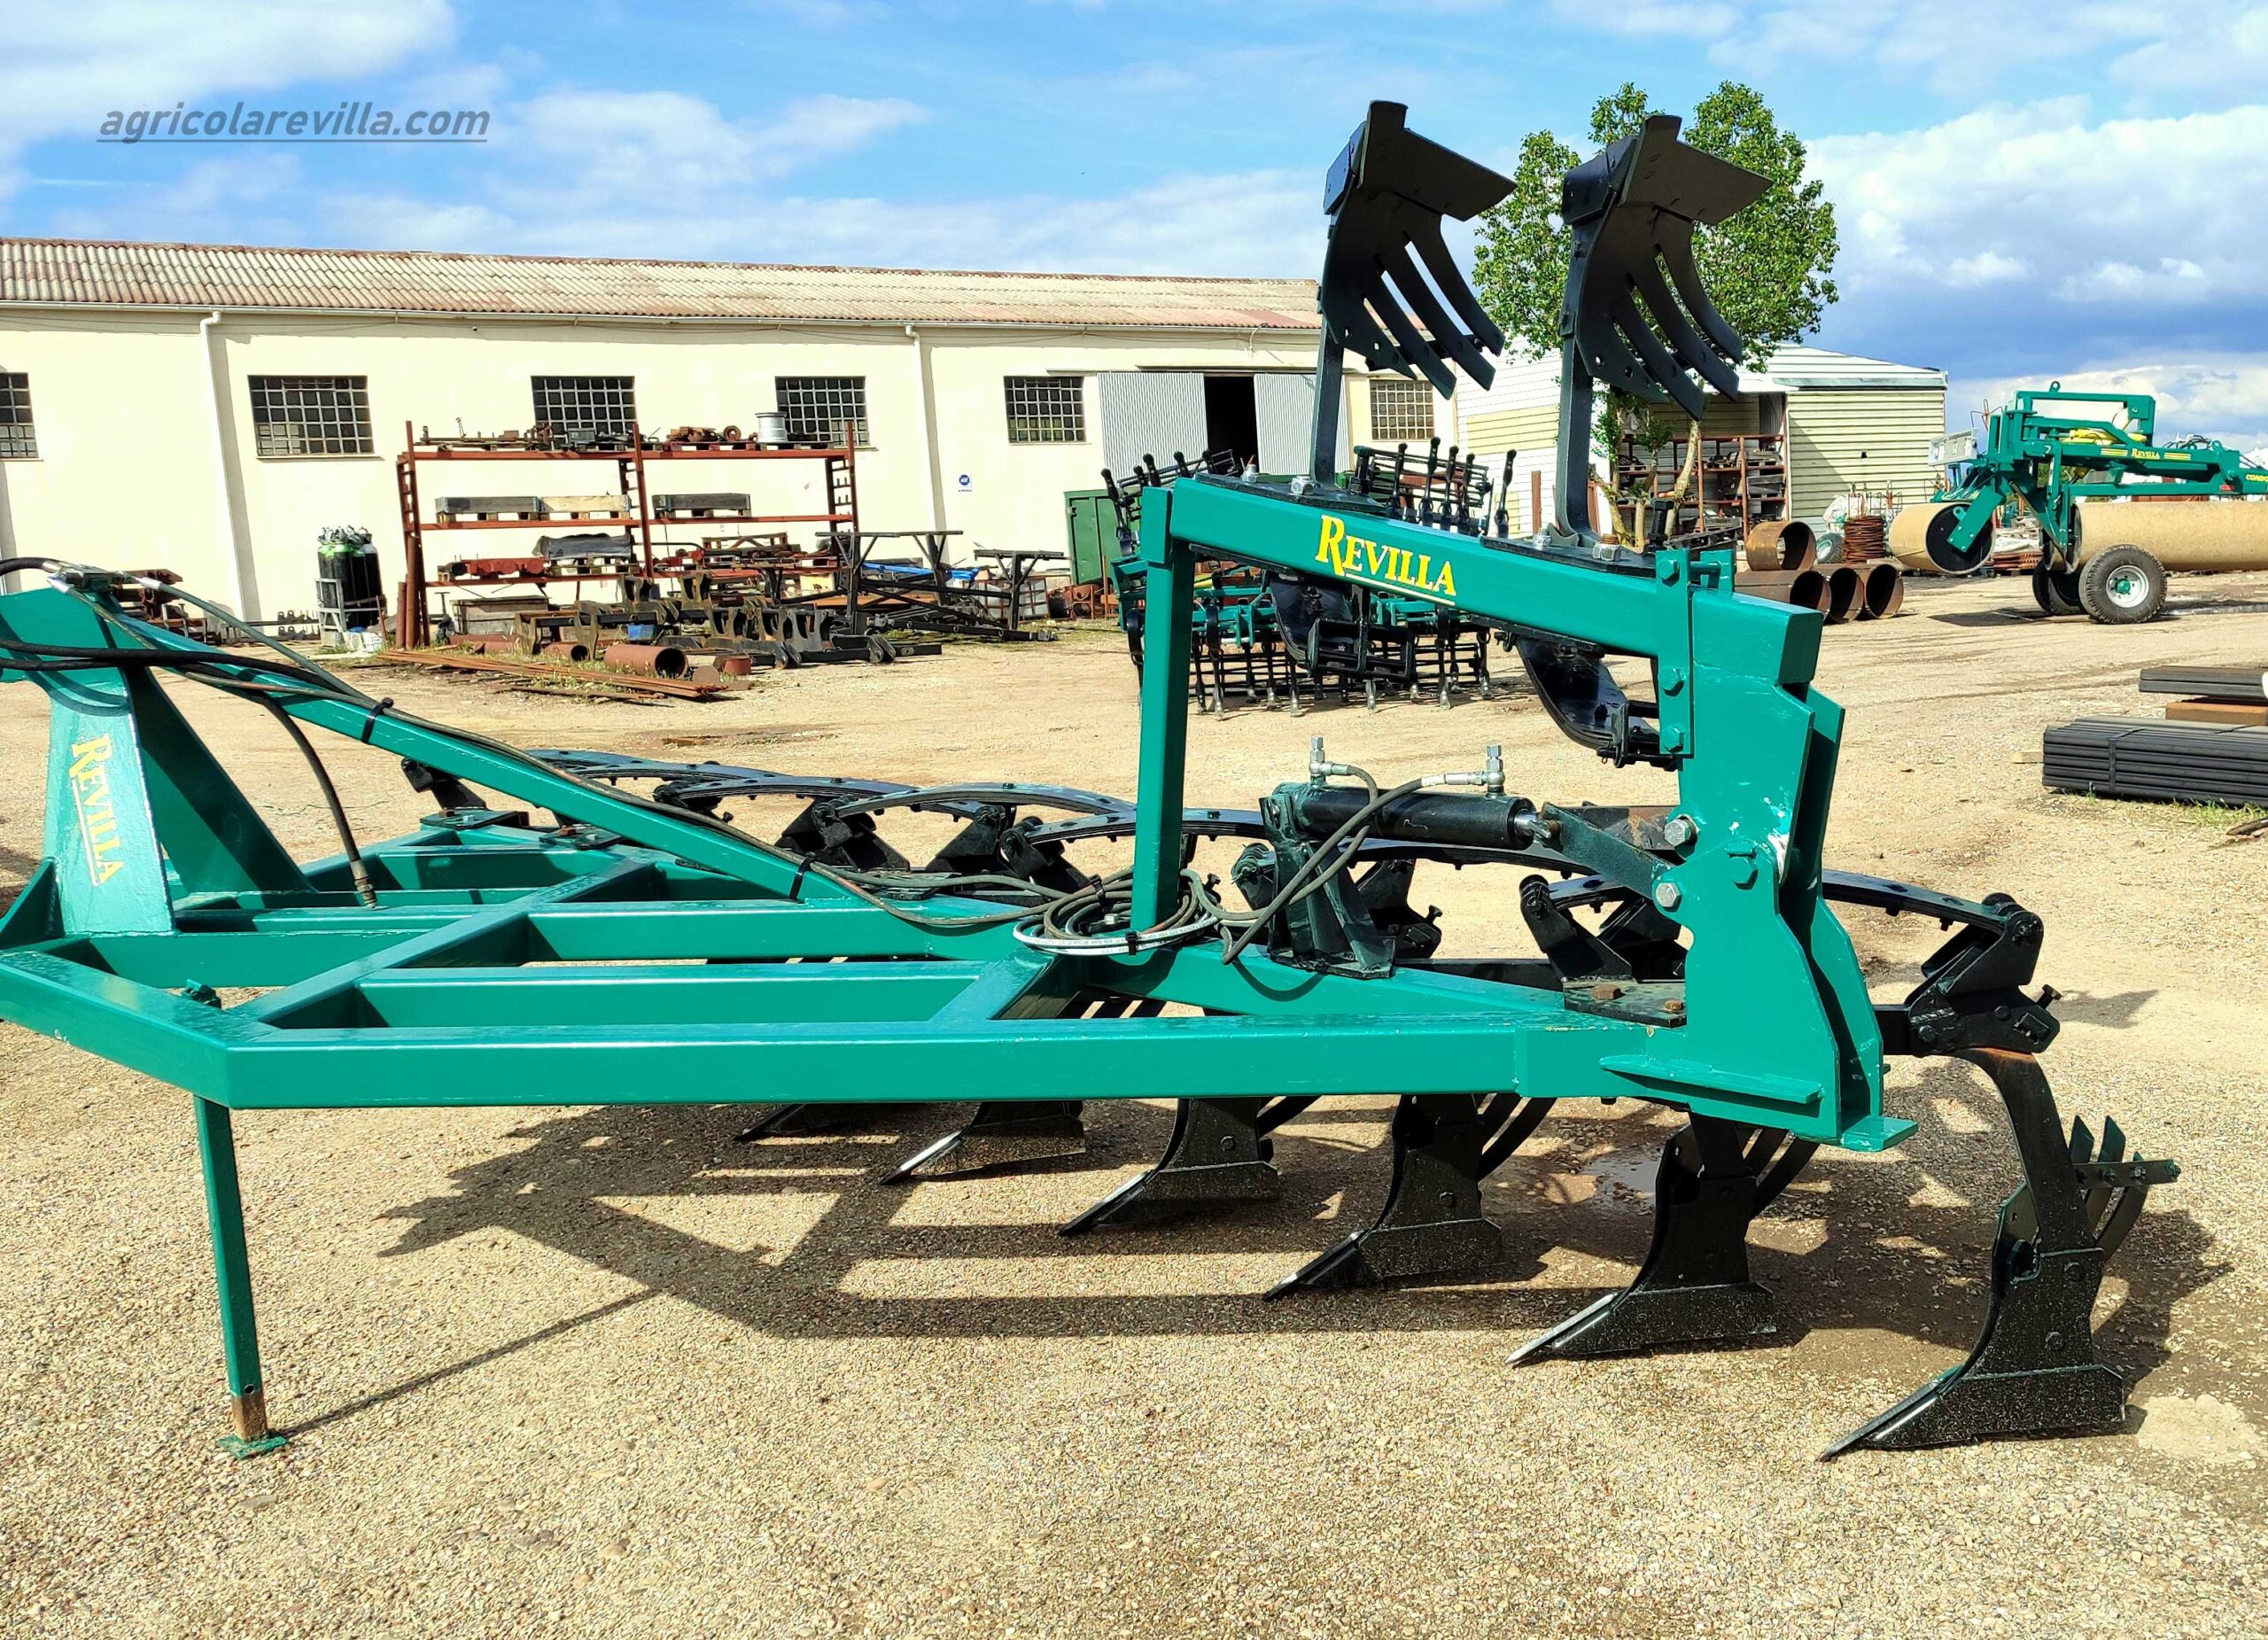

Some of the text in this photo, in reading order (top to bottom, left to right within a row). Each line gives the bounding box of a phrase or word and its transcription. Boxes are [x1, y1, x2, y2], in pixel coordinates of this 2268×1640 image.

[2132, 447, 2160, 460] REVILLA
[1315, 514, 1456, 596] REVILLA
[68, 732, 124, 884] REVILLA
